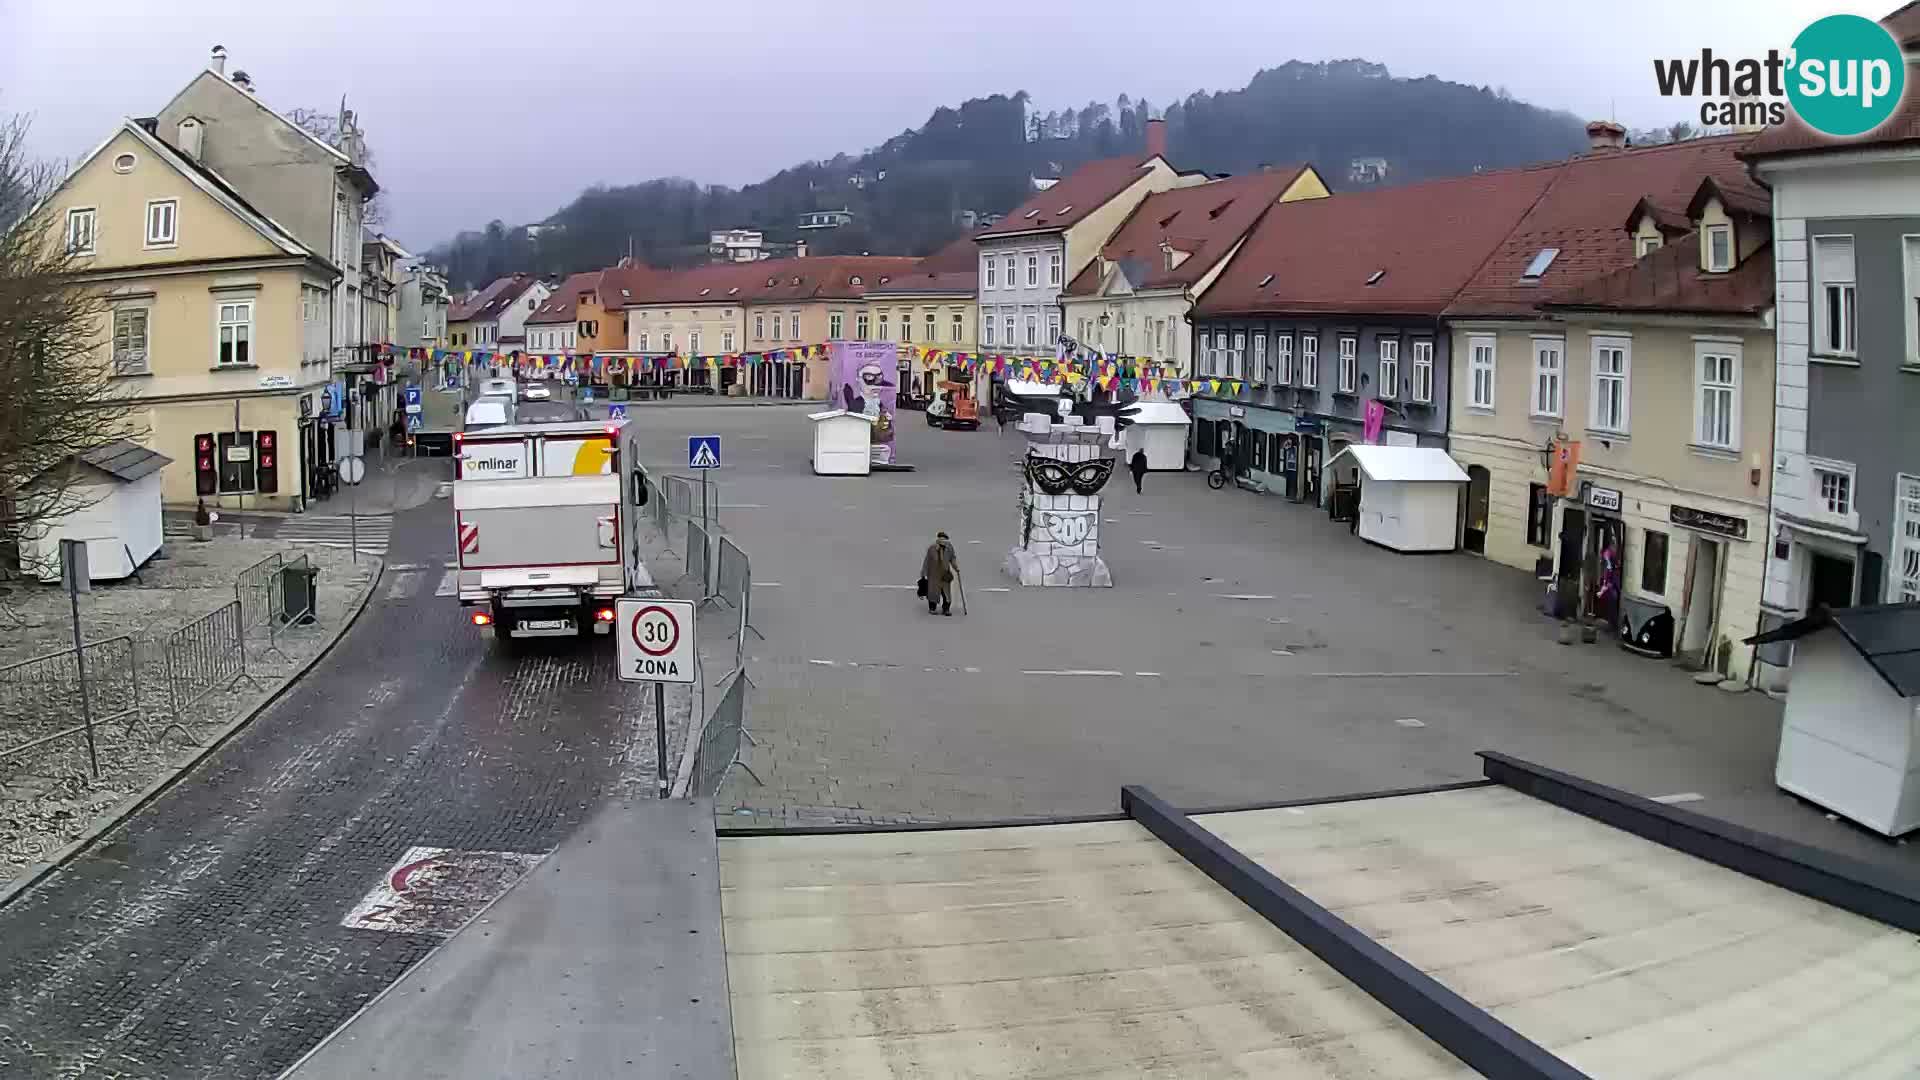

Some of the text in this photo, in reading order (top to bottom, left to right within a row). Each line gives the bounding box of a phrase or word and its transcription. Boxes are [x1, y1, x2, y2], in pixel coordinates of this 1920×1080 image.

[478, 457, 518, 471] mlinar
[1048, 516, 1087, 545] 200
[644, 621, 668, 643] 30
[634, 659, 679, 676] ZONA
